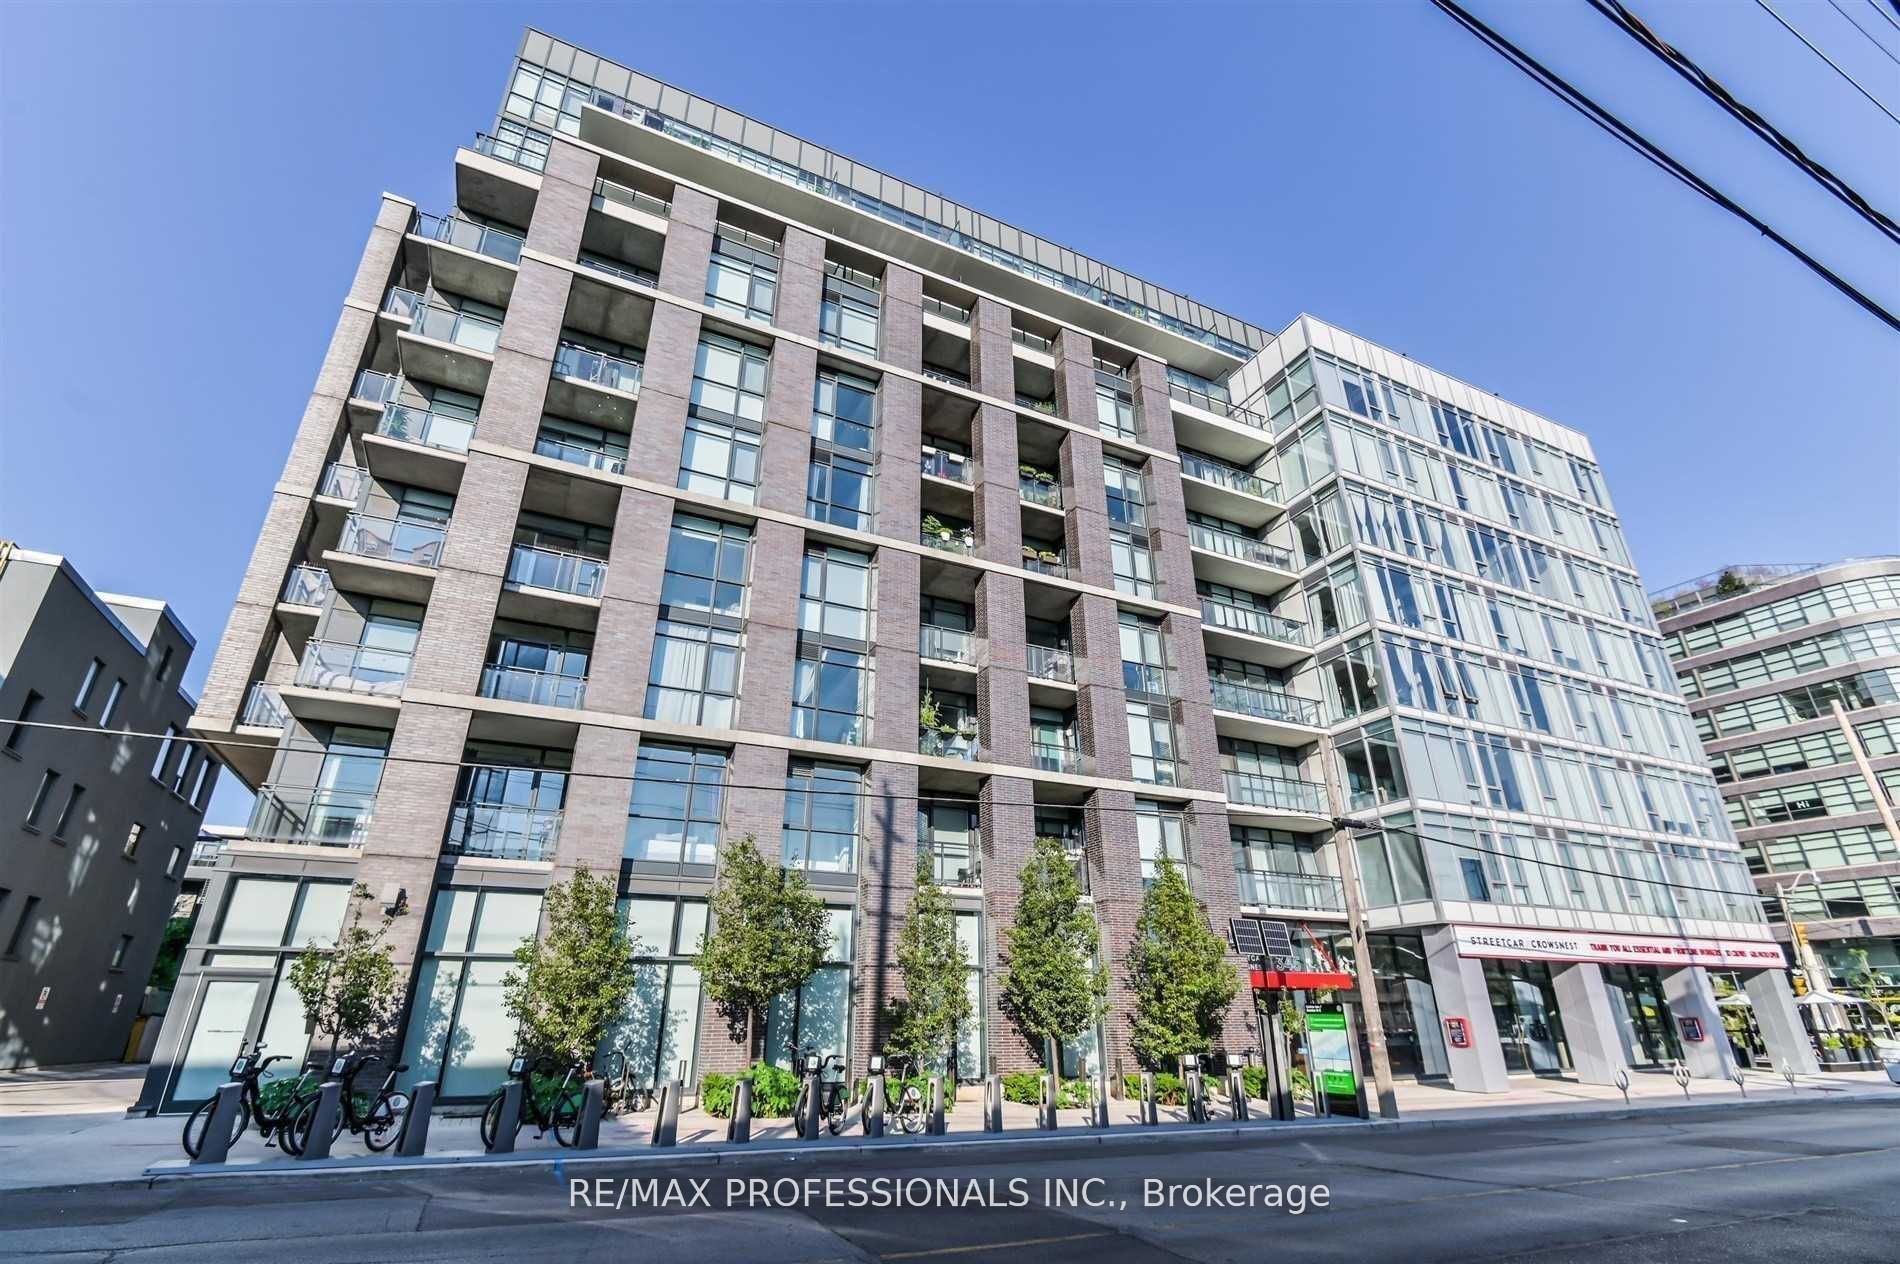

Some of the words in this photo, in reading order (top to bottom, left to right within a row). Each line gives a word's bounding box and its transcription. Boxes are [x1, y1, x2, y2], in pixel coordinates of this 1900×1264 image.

[1796, 800, 1810, 809] Hi
[1470, 936, 1523, 947] STREETCAR
[1531, 939, 1578, 950] CROWSNEST
